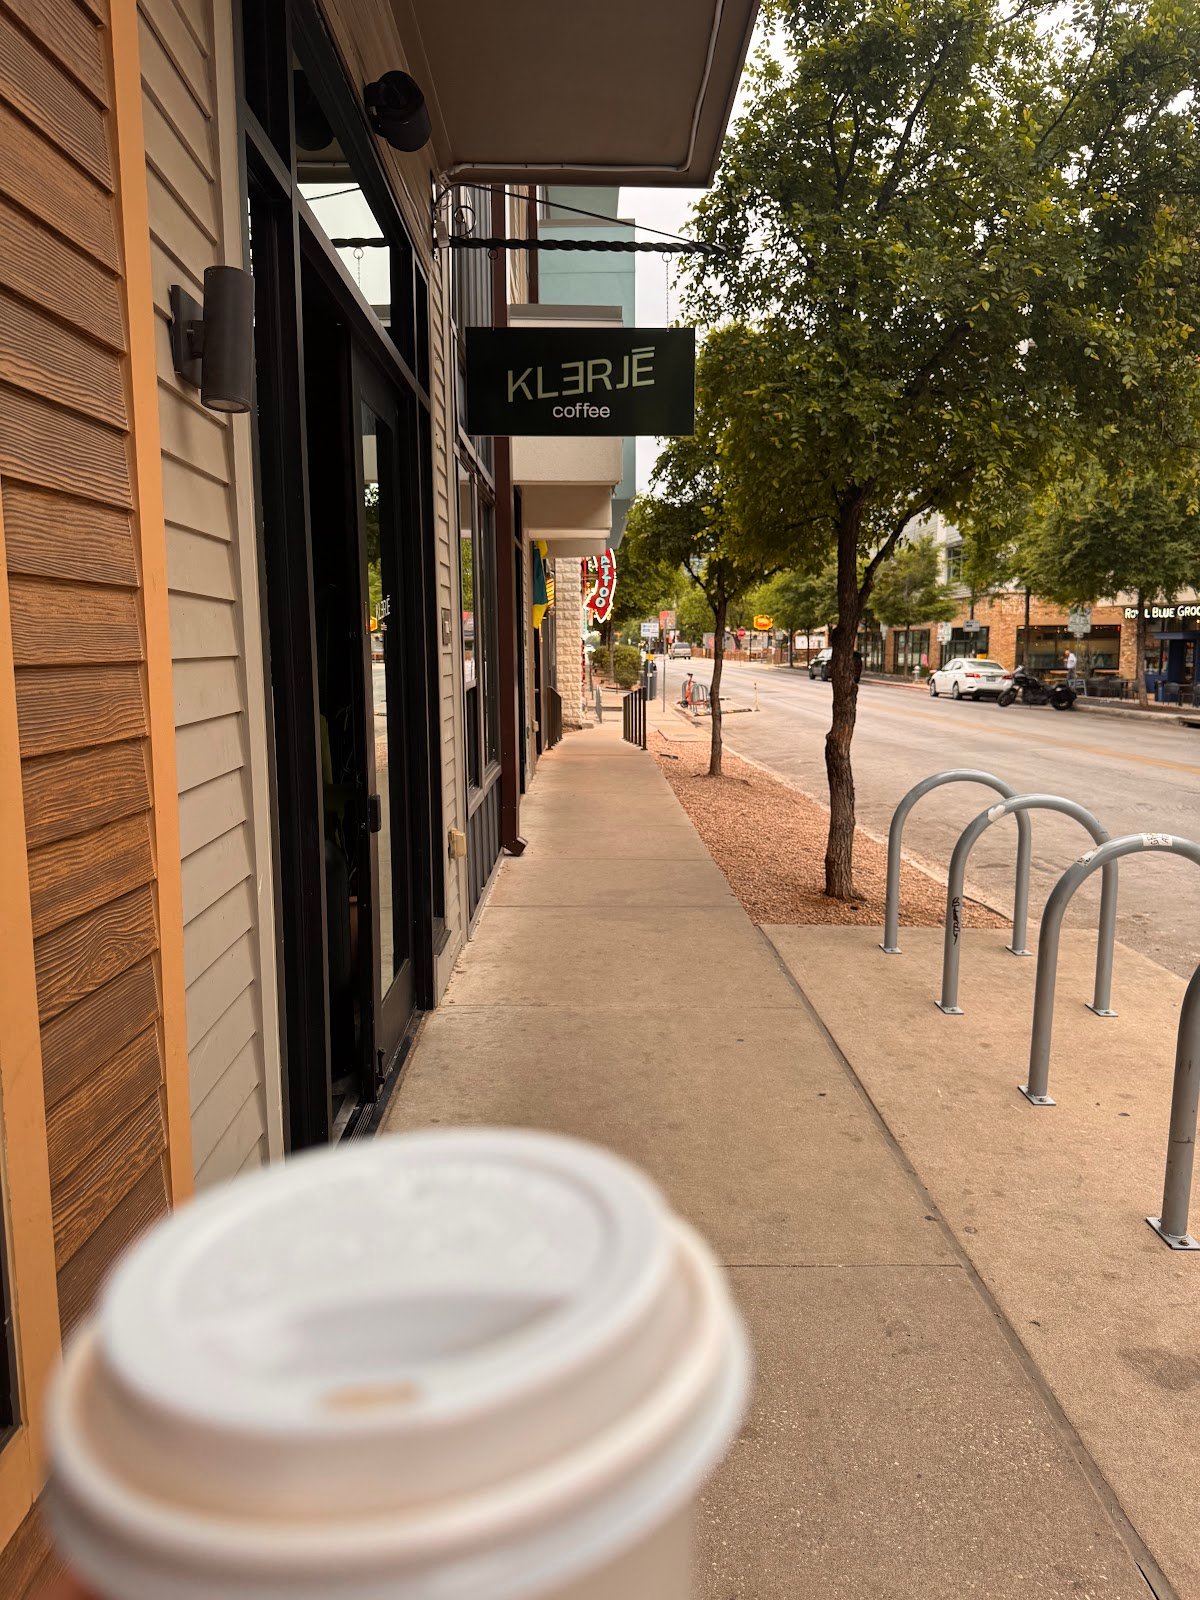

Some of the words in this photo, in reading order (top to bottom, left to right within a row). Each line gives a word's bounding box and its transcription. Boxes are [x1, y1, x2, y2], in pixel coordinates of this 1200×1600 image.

[552, 402, 611, 418] coffee
[595, 555, 611, 608] ATTOO
[1124, 607, 1151, 619] ROL
[1152, 606, 1175, 619] BLUE
